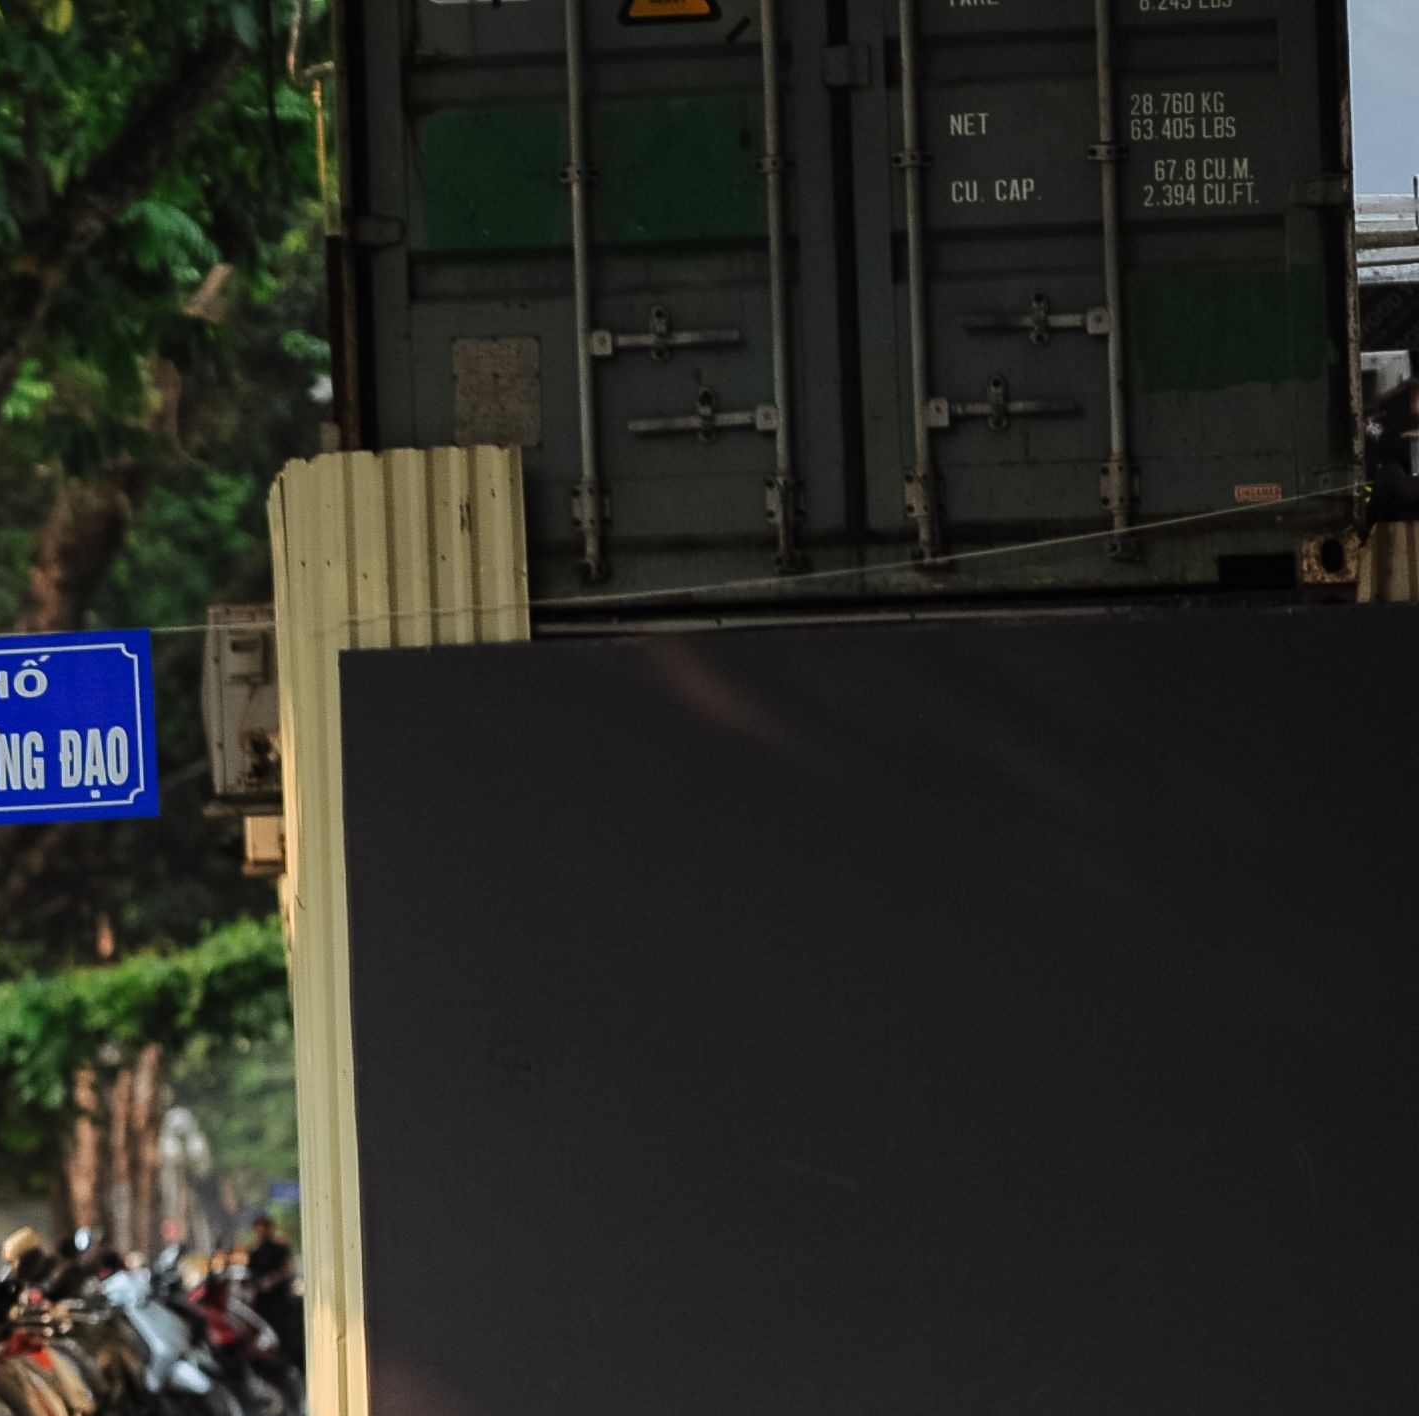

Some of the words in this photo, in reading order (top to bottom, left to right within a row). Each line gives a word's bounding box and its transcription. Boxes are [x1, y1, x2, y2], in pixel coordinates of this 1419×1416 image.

[1130, 92, 1194, 115] 28.760
[1201, 91, 1224, 114] KG
[949, 112, 989, 136] NET
[1130, 117, 1195, 140] 63.405
[1202, 116, 1236, 139] LBS
[1154, 158, 1196, 182] 67.8
[1143, 184, 1196, 207] 2.394
[59, 724, 129, 799] ĐẠO
